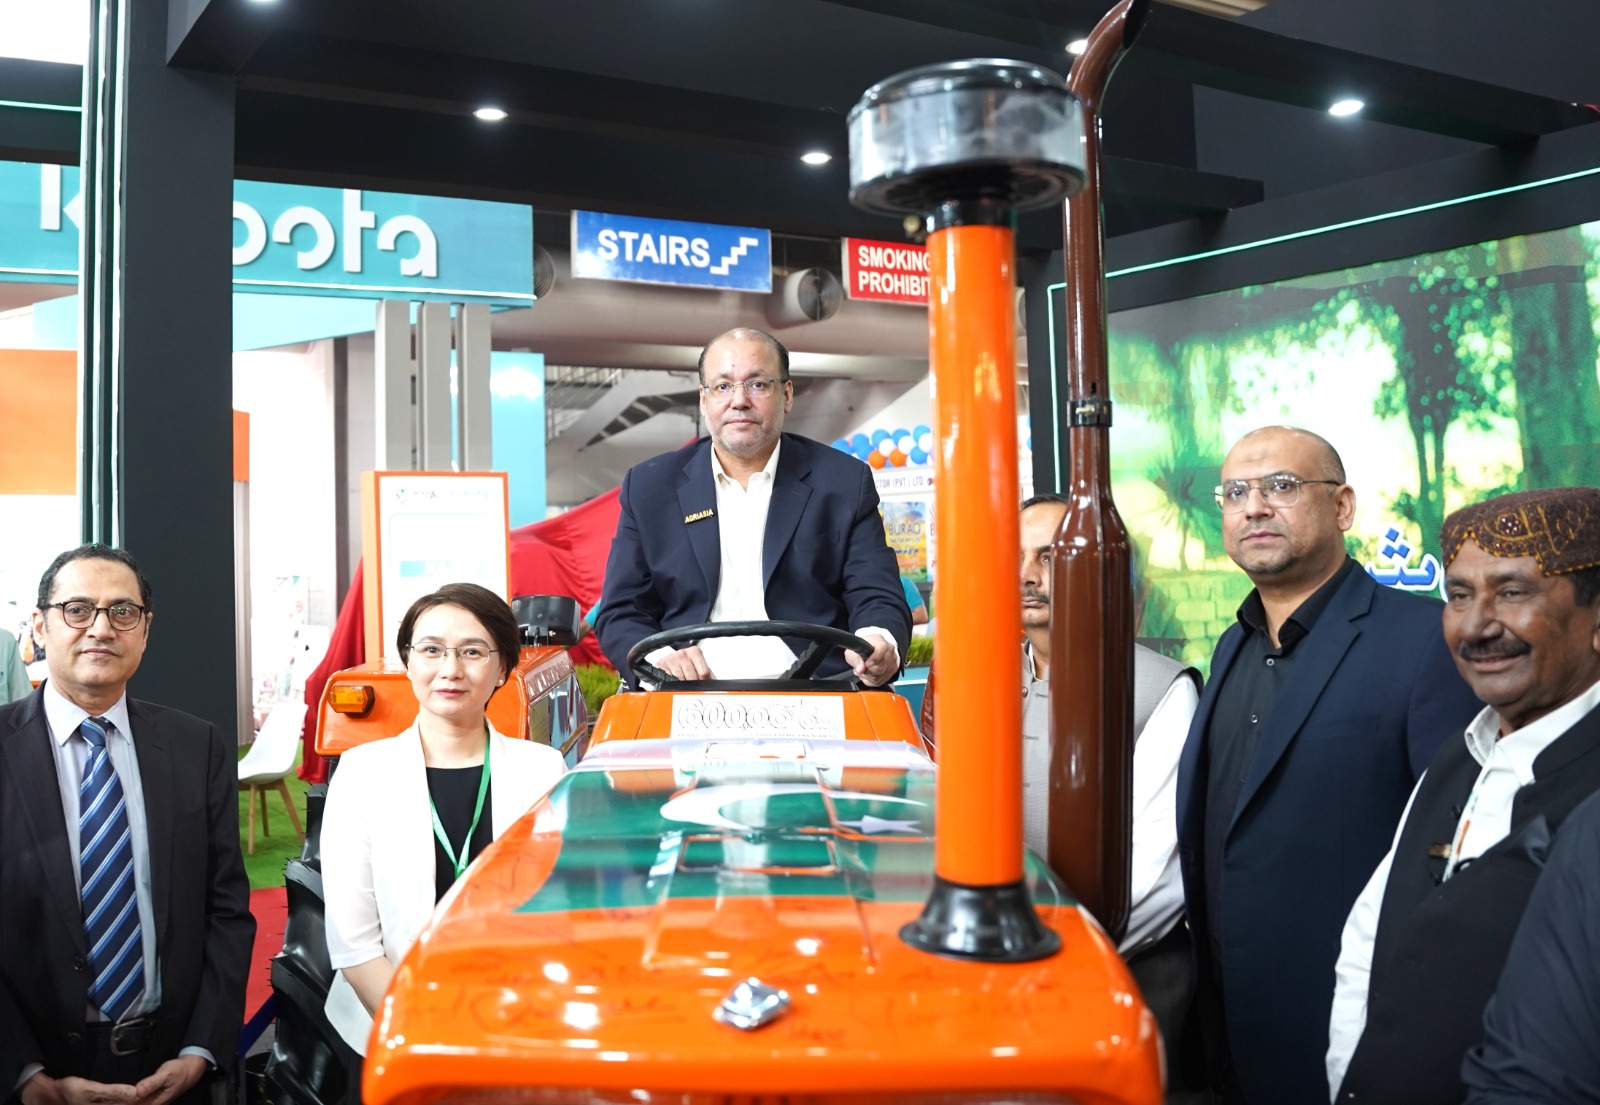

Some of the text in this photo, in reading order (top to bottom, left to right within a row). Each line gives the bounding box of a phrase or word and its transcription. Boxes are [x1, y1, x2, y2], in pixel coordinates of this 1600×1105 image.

[597, 229, 711, 268] STAIRS
[684, 508, 714, 524] AGRIASIA
[888, 522, 921, 536] BURAO
